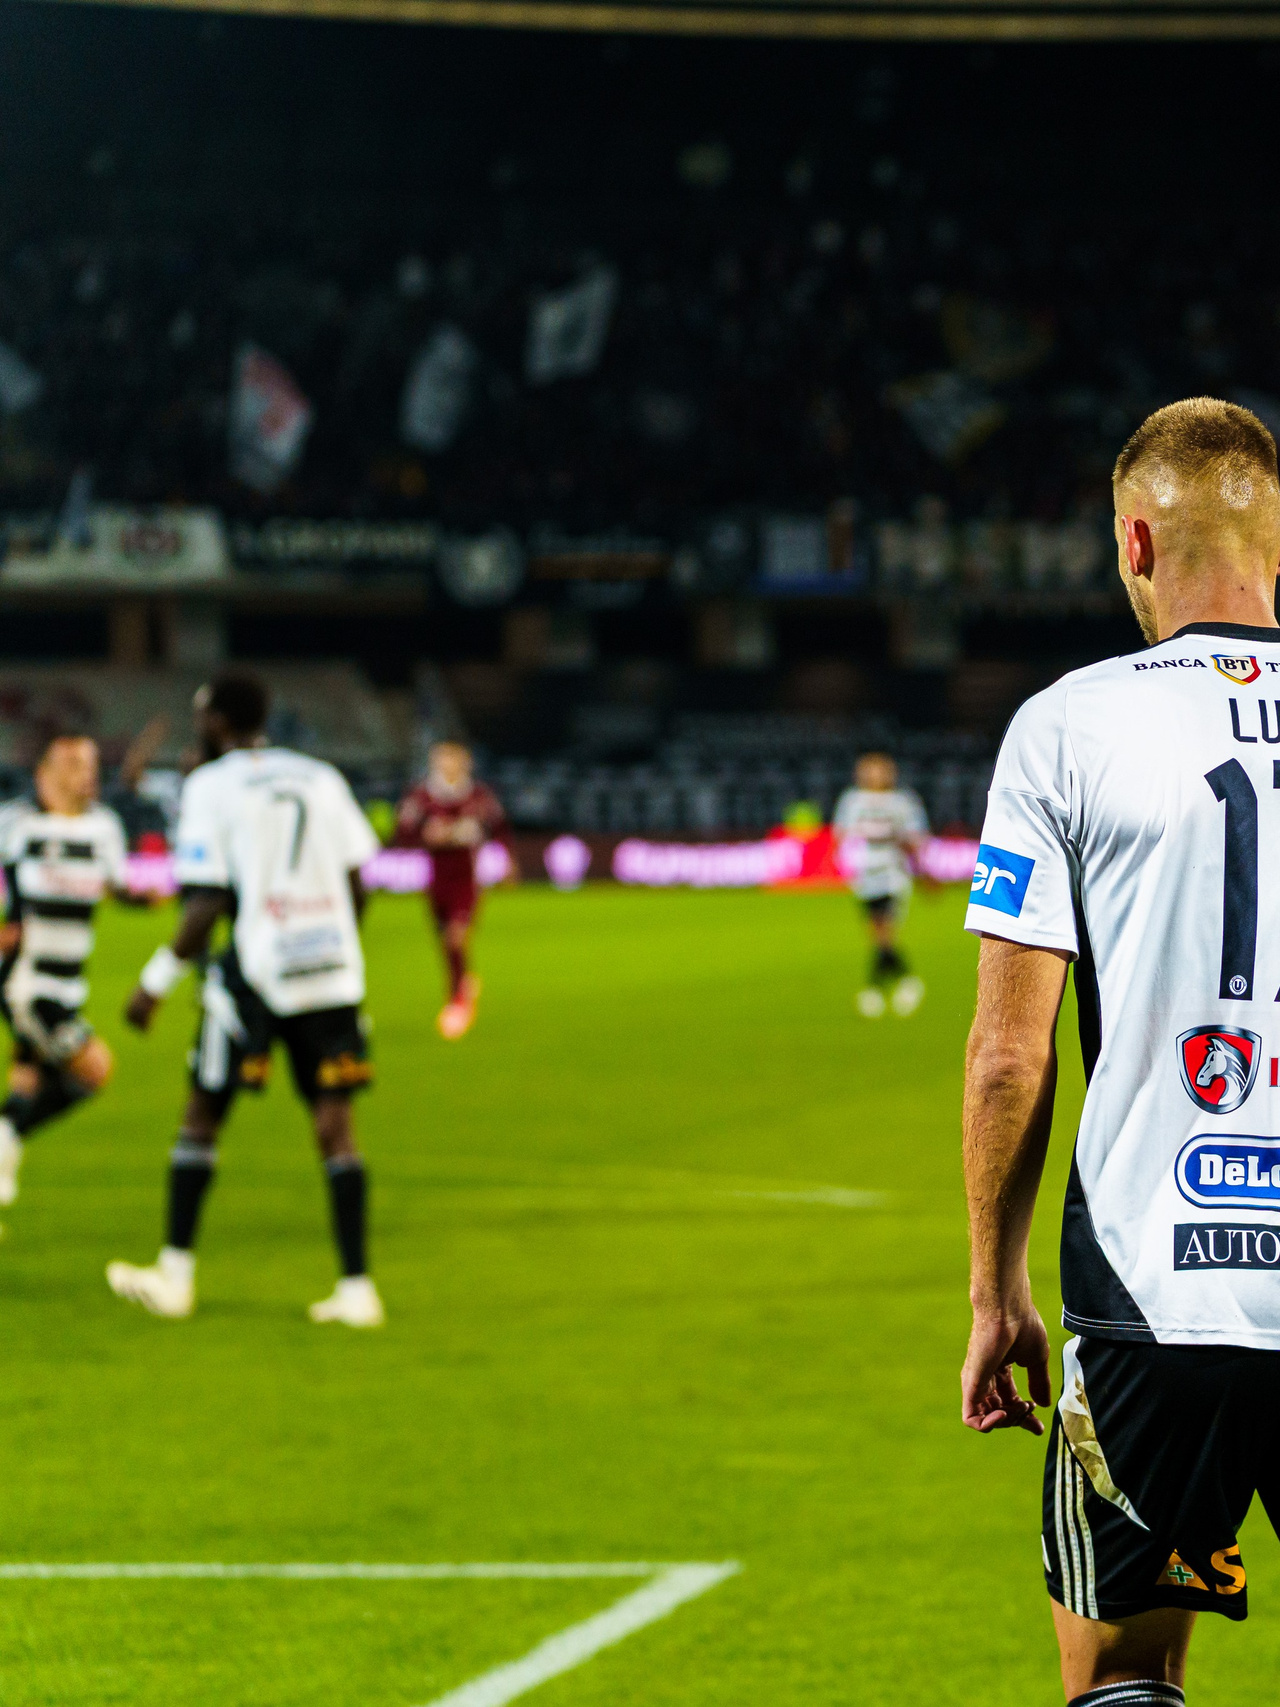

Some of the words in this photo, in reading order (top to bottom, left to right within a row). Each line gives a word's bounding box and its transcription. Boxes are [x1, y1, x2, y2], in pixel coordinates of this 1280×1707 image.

[1132, 658, 1207, 672] BANCA
[1221, 658, 1250, 671] BT
[270, 788, 308, 875] 7
